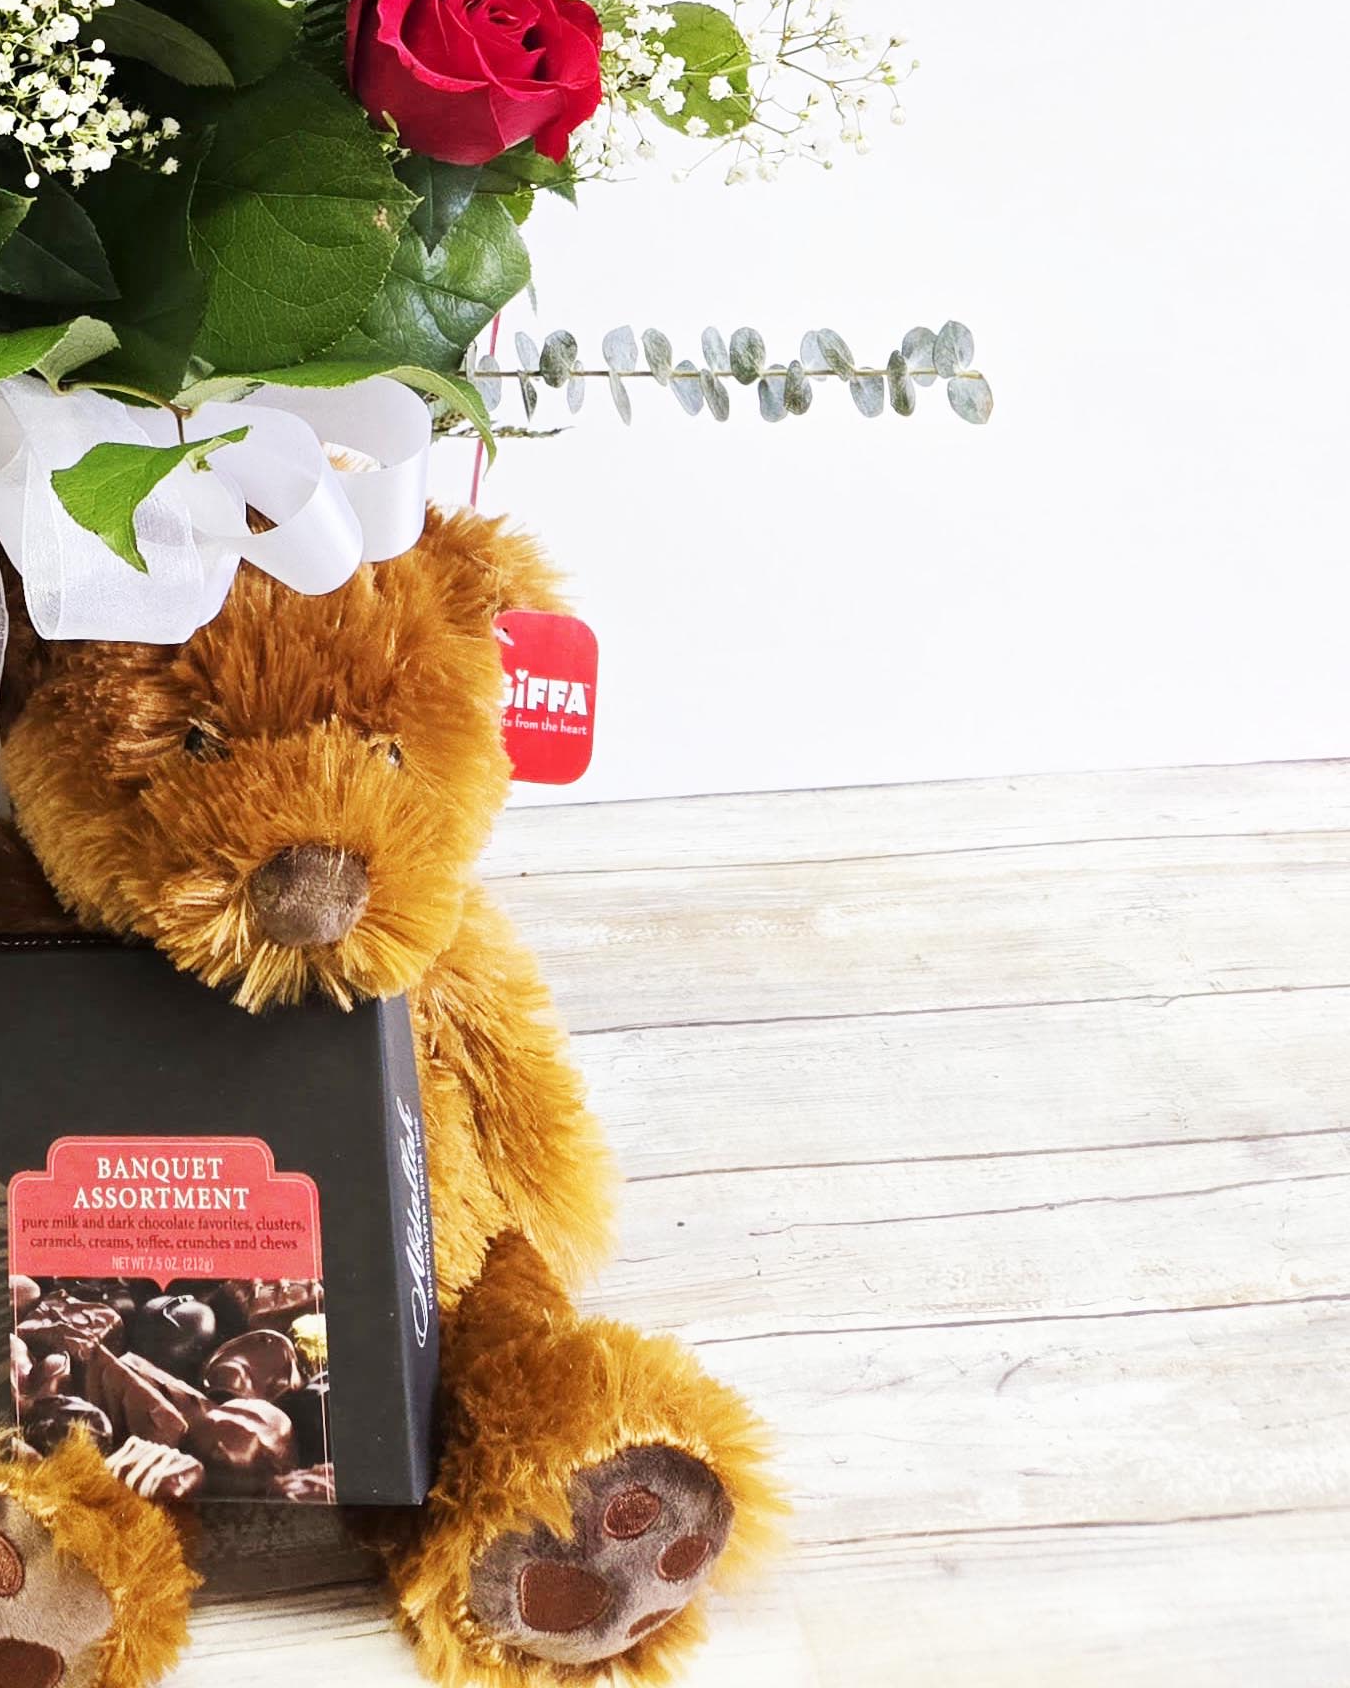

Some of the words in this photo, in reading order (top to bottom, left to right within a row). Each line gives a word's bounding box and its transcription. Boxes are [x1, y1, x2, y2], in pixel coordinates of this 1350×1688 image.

[515, 713, 539, 730] from
[541, 716, 558, 732] the
[560, 718, 587, 736] heart
[97, 1157, 223, 1183] BANQUET
[73, 1187, 250, 1210] ASSORTMENT
[22, 1217, 49, 1233] pure
[52, 1214, 79, 1229] milk
[82, 1215, 105, 1230] and
[107, 1215, 136, 1230] dark
[138, 1214, 195, 1231] chocolate
[255, 1215, 307, 1233] clusters,
[396, 1096, 428, 1347] Abdallah
[30, 1234, 85, 1250] caramels,
[88, 1237, 134, 1250] creams,
[176, 1234, 231, 1250] crunches
[233, 1234, 257, 1250] and
[259, 1234, 299, 1251] chews
[112, 1255, 130, 1270] NET
[130, 1255, 146, 1270] WT
[147, 1255, 163, 1271] 7.5
